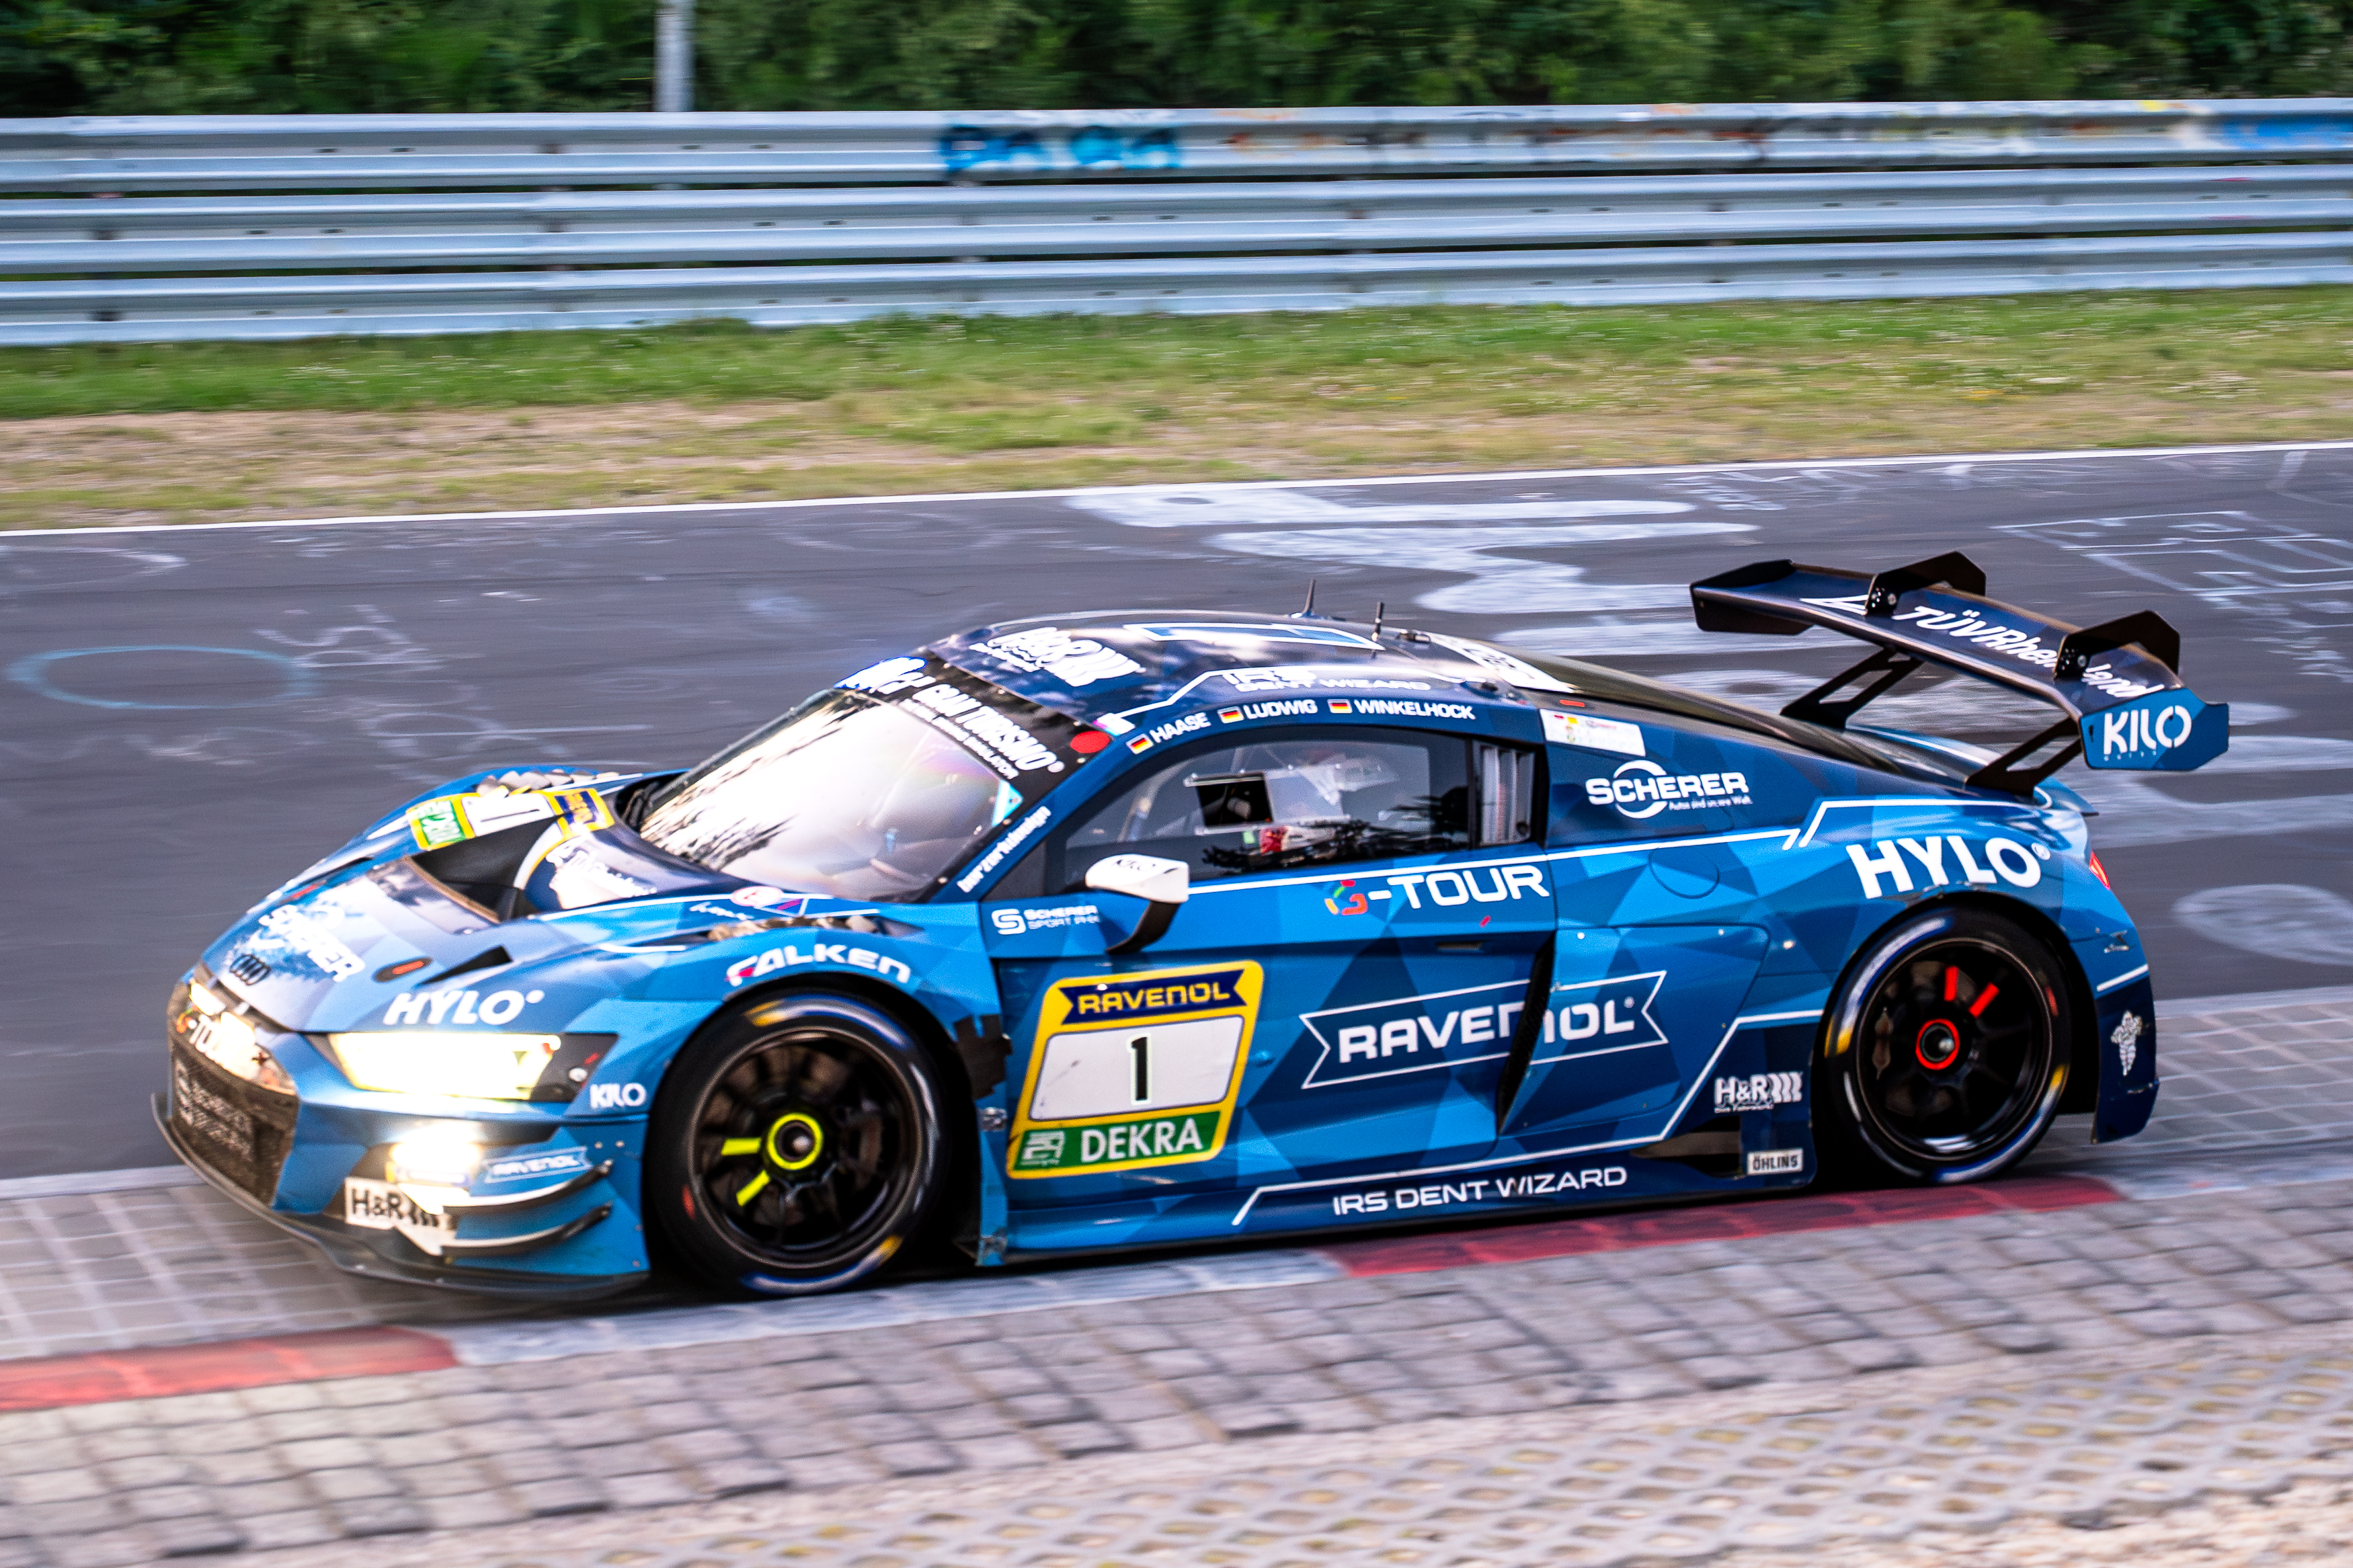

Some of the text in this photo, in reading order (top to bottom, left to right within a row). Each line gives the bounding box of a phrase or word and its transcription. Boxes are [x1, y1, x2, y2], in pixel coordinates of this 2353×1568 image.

[1150, 698, 1476, 743] HAASE LUDWIG WINKELHOCK
[2103, 704, 2192, 753] KILO
[1585, 772, 1751, 806] SCHERER
[725, 943, 912, 988] FALKEN
[1077, 982, 1232, 1015] RAVENOL
[1131, 1036, 1148, 1102] 1
[590, 1083, 646, 1110] KILO
[1080, 1117, 1205, 1163] DEKRA
[1753, 1155, 1798, 1171] ÖHLINS
[1333, 1166, 1627, 1215] IRS DENT WIZARD
